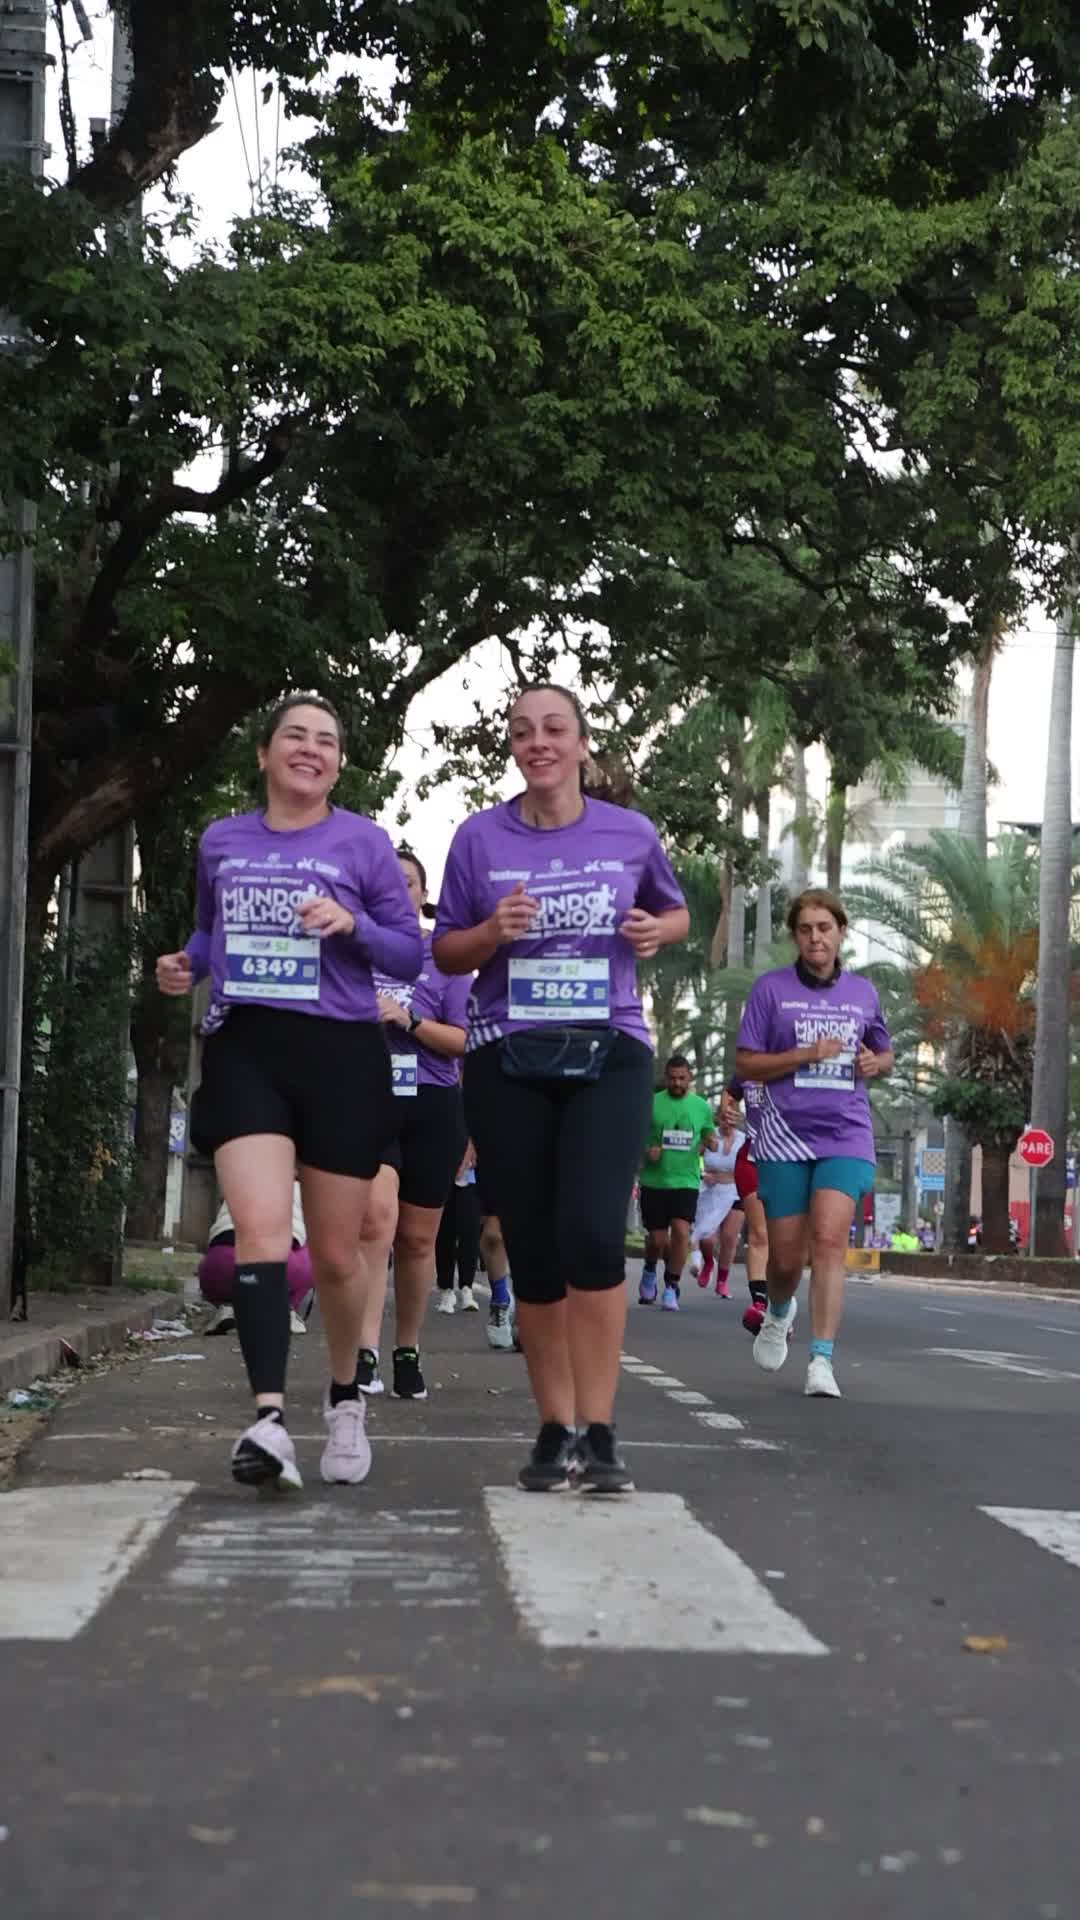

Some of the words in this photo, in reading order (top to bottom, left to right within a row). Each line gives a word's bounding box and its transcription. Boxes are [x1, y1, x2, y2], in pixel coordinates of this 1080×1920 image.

[222, 887, 304, 908] MUNDO
[223, 904, 294, 924] MELHO
[242, 957, 298, 977] 6349
[531, 982, 588, 1000] 5862
[1020, 1141, 1051, 1155] PARE
